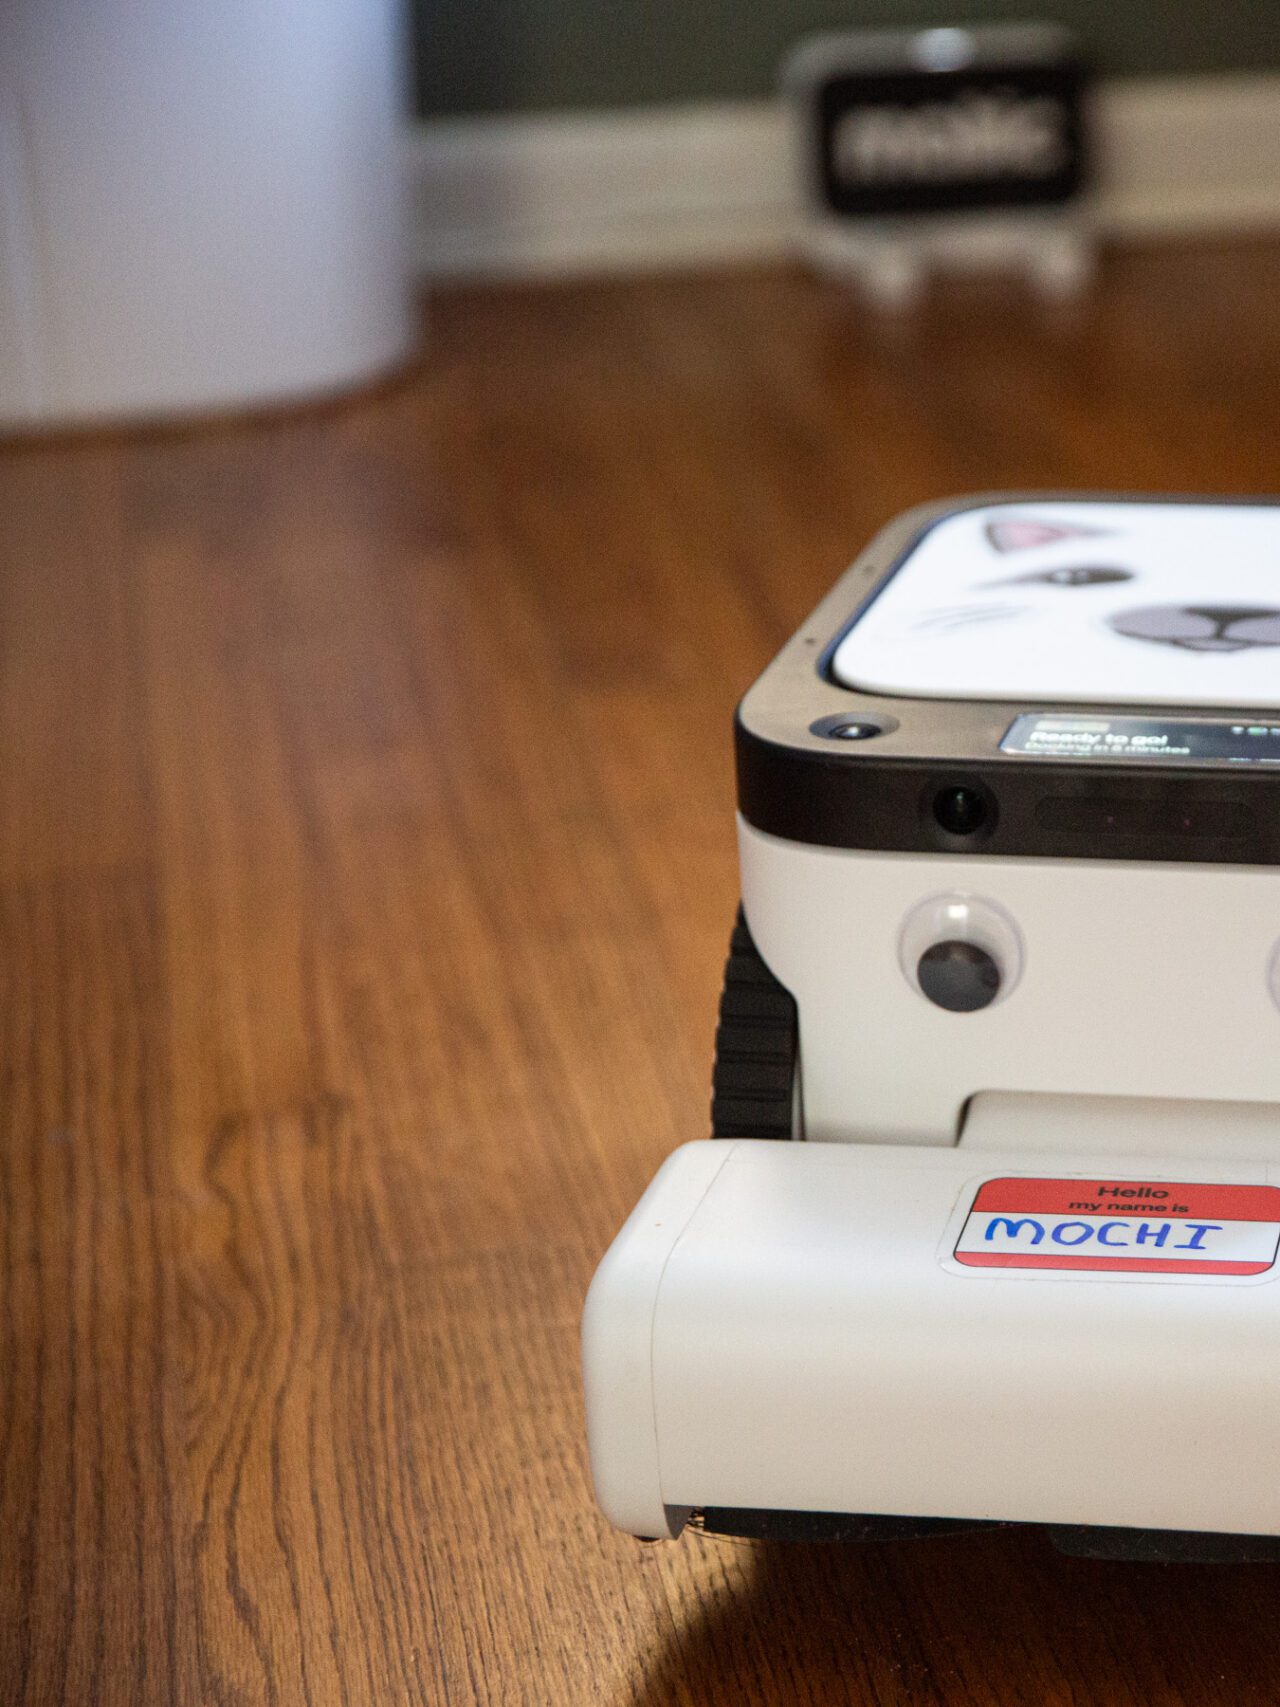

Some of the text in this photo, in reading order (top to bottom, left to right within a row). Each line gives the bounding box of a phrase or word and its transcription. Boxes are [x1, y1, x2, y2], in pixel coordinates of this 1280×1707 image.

[1030, 731, 1169, 747] Ready to go!
[1097, 1186, 1169, 1199] Hello
[1068, 1202, 1189, 1212] my name is
[984, 1217, 1224, 1250] MOCHI
